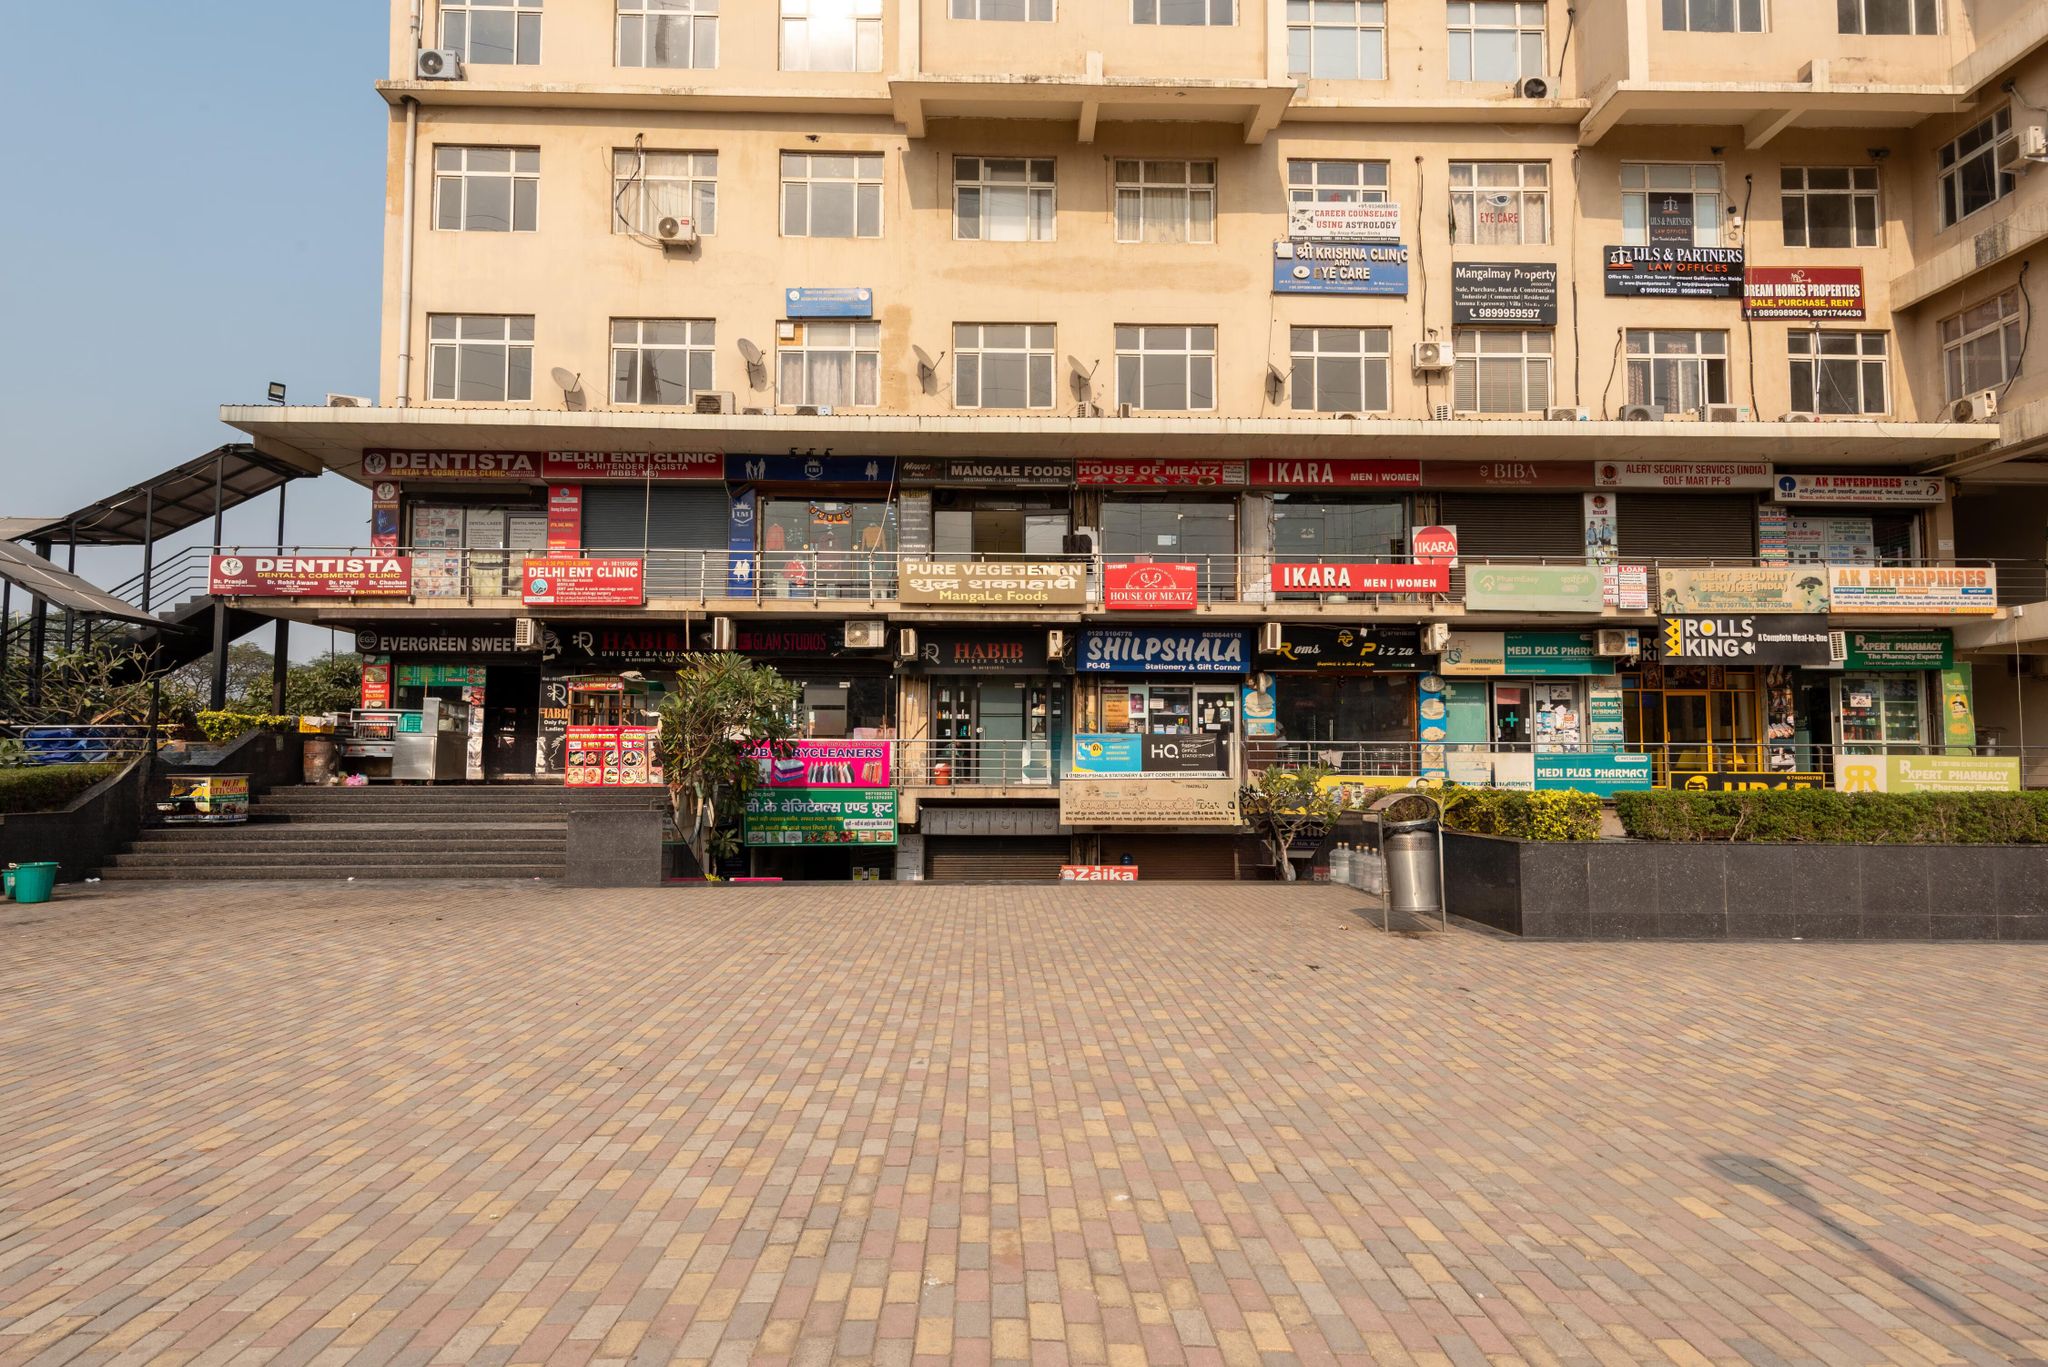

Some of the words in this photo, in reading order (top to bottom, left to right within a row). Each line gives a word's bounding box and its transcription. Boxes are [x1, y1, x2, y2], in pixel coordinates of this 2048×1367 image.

[1348, 210, 1398, 218] COUNSELING
[1480, 213, 1494, 223] EYE
[1497, 212, 1518, 223] CARE
[1316, 221, 1343, 229] USING
[1345, 221, 1397, 229] ASTROLOGY
[1665, 217, 1692, 226] PARTNERS
[1316, 248, 1367, 260] KRISHNA
[1634, 247, 1660, 261] IJLS
[1663, 248, 1673, 260] &
[1677, 248, 1743, 263] PARTNERS
[1340, 267, 1371, 279] CARE
[1677, 264, 1728, 273] OFFICES
[1456, 267, 1511, 281] Mangalmay
[1514, 269, 1556, 282] Property
[1744, 284, 1774, 297] DREAM
[1774, 284, 1806, 297] HOMES
[1807, 284, 1861, 297] PROPERTIES
[1751, 299, 1777, 307] SALE,
[1778, 299, 1829, 307] PURCHASE,
[1830, 299, 1855, 307] RENT
[1479, 309, 1540, 318] 9899959597
[390, 452, 533, 470] DENTISTA
[548, 452, 604, 462] DELHI
[610, 452, 649, 462] ENT
[653, 453, 717, 463] CLINIC
[391, 468, 420, 476] DENTAL
[648, 463, 688, 471] BASISTA
[951, 465, 1020, 476] MANGALE
[1024, 466, 1072, 477] FOODS
[1078, 465, 1134, 476] HOUSE
[1139, 465, 1160, 475] OF
[1165, 465, 1220, 476] MEATZ
[1268, 462, 1334, 483] IKARA
[1350, 473, 1373, 481] MEN
[1381, 473, 1419, 482] WOMEN
[1494, 463, 1537, 478] BIBA
[1626, 464, 1651, 474] ALERT
[1654, 464, 1693, 474] SECURITY
[1695, 464, 1735, 474] SERVICES
[1737, 464, 1767, 475] (INDIA)
[1663, 476, 1683, 485] GOLF
[1685, 476, 1708, 485] MART
[1711, 476, 1731, 486] PF-8
[1815, 477, 1829, 487] AK
[1833, 477, 1902, 487] ENTERPRISES
[255, 558, 402, 573] DENTISTA
[906, 564, 956, 575] PURE
[528, 567, 565, 578] DELHI
[569, 567, 593, 578] ENT
[596, 567, 638, 578] CLINIC
[1283, 567, 1351, 588] IKARA
[1363, 578, 1387, 588] MEN
[1396, 578, 1437, 588] WOMEN
[1691, 571, 1731, 582] ALERT
[1736, 571, 1796, 582] SECURITY
[1838, 569, 1862, 586] AK
[1868, 569, 1986, 587] ENTERPRISES
[909, 578, 962, 592] शुद्ध
[1701, 582, 1753, 593] SERVICE
[939, 590, 1003, 603] MangaLe
[1007, 590, 1049, 601] Foods
[1110, 591, 1142, 601] HOUSE
[1144, 591, 1158, 601] OF
[1160, 591, 1193, 601] MEATZ
[1685, 619, 1754, 637] ROLLS
[380, 636, 467, 651] EVERGREEN
[753, 633, 782, 650] GLAM
[783, 633, 827, 650] STUDIOS
[1758, 633, 1763, 642] A
[1763, 633, 1792, 643] Complete
[954, 642, 1024, 658] HABIB
[1087, 637, 1242, 662] SHILPSHALA
[1507, 646, 1532, 655] MEDI
[1535, 646, 1559, 655] PLUS
[1687, 639, 1740, 657] KING
[1895, 642, 1943, 651] PHARMACY
[1882, 653, 1916, 661] Pharmacy
[1916, 653, 1943, 661] Experts
[1145, 663, 1187, 671] Stationery
[1197, 663, 1212, 671] Gift
[1537, 768, 1563, 778] MEDI
[1566, 768, 1592, 778] PLUS
[1595, 768, 1648, 778] PHARMACY
[1948, 771, 2008, 780] PHARMACY
[1075, 868, 1134, 880] Zaika
